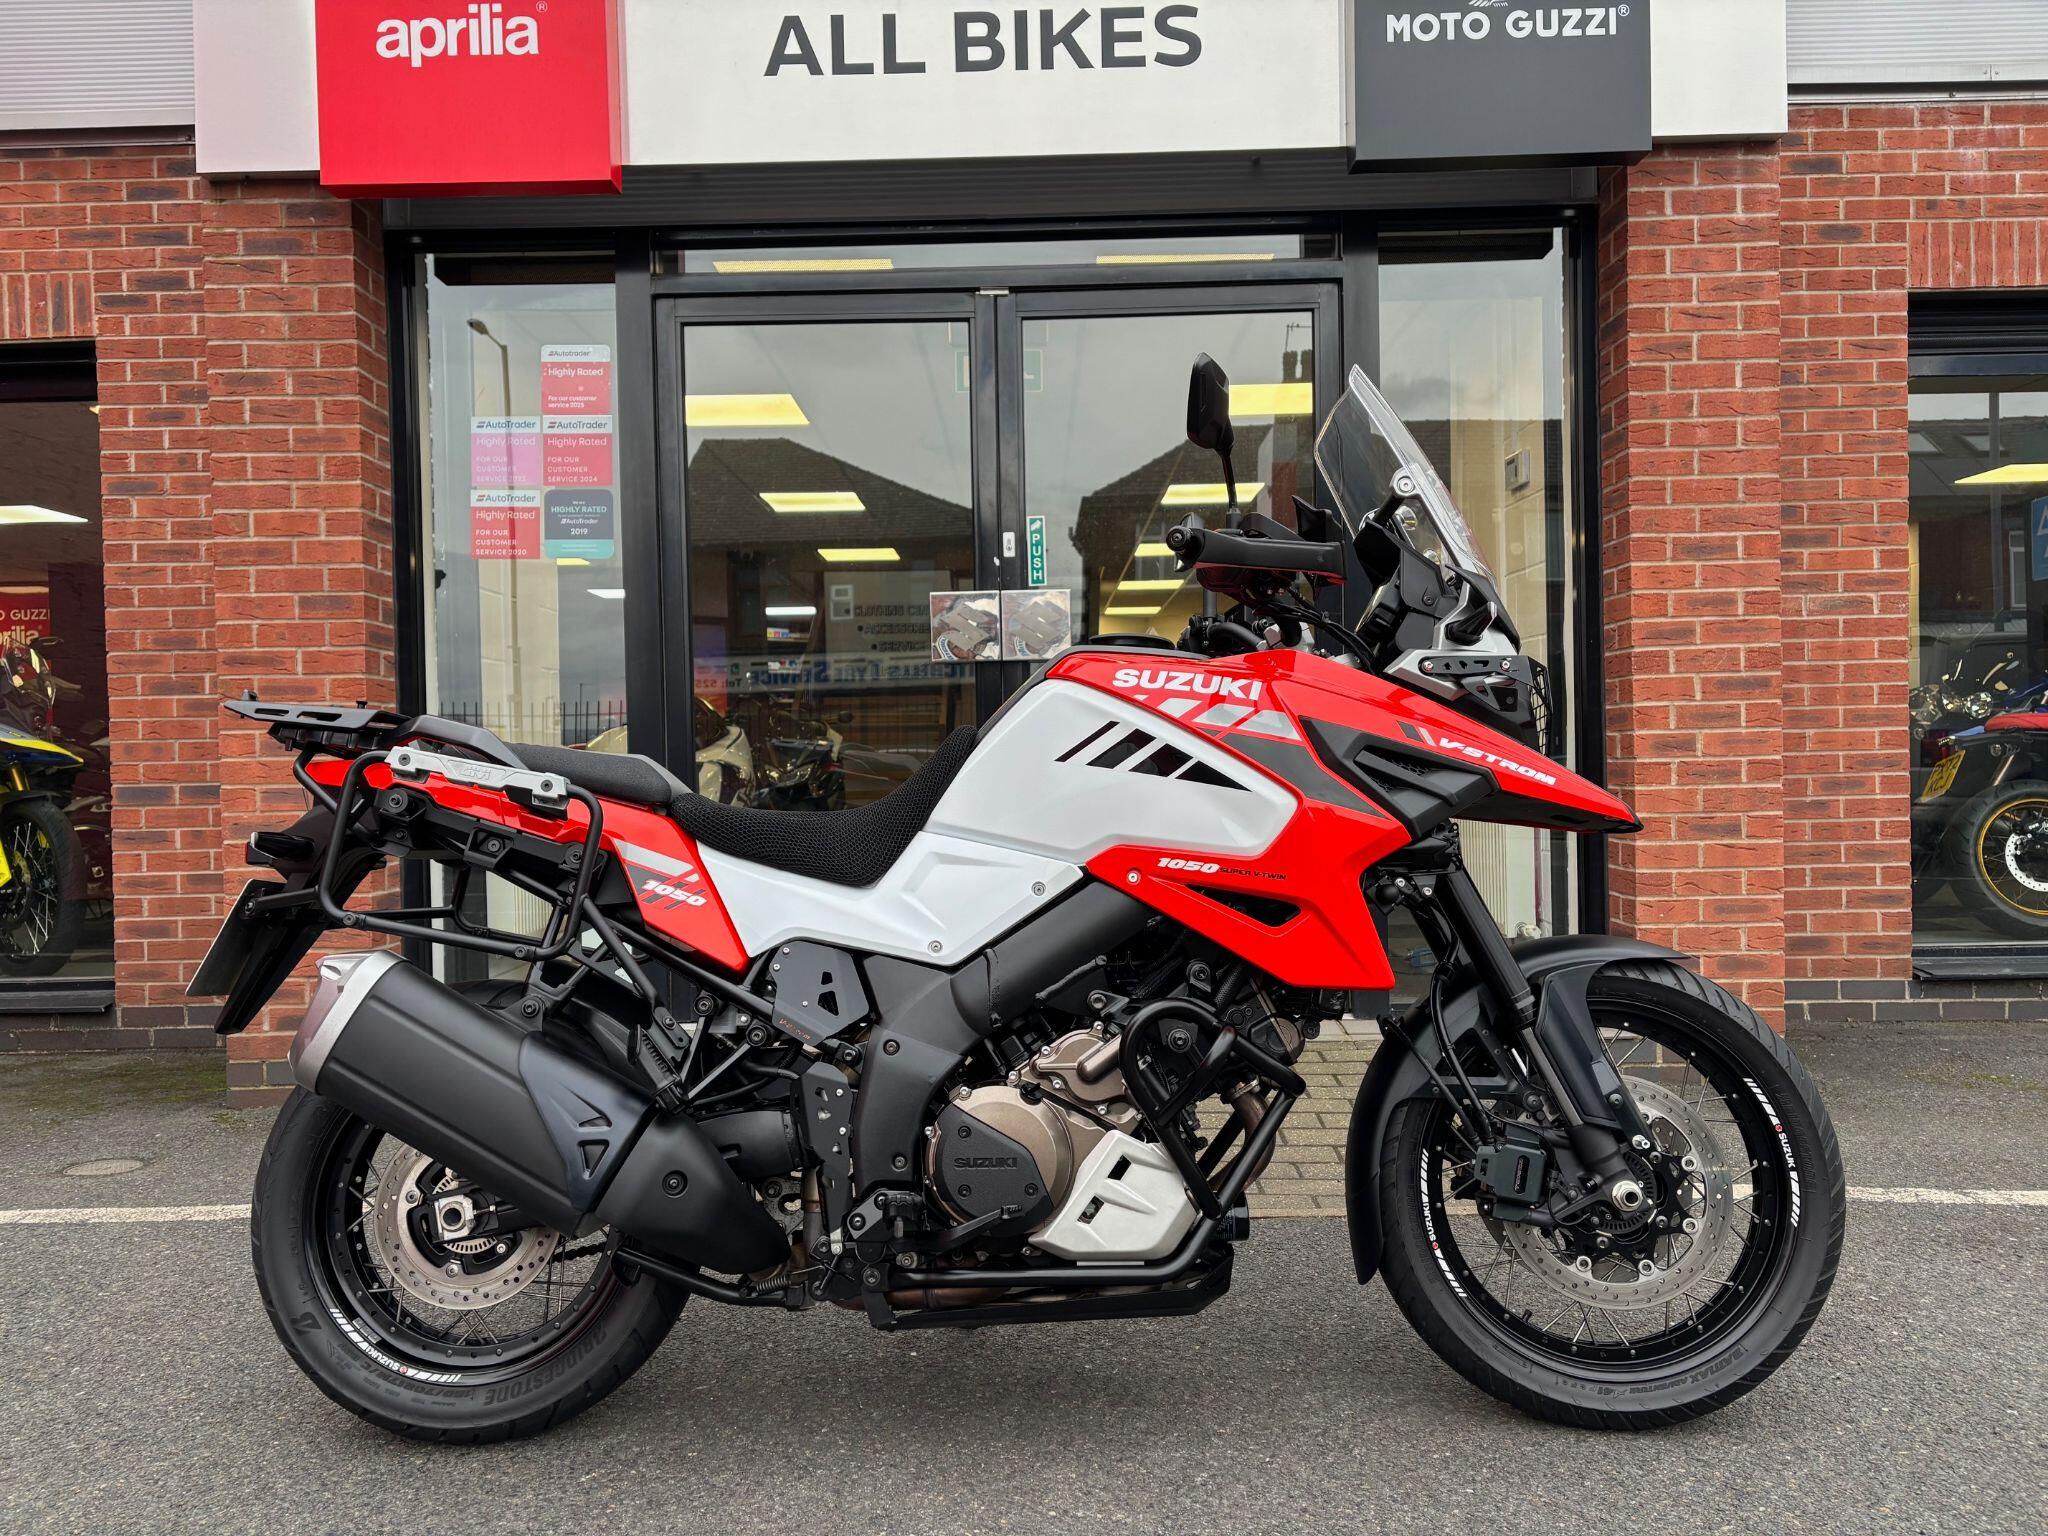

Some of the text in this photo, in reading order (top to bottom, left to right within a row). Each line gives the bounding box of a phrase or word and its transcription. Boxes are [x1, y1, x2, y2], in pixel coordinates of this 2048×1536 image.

[375, 3, 540, 68] aprilia
[1386, 7, 1617, 43] MOTO GUZZI
[763, 4, 1203, 77] ALL BIKES
[548, 368, 604, 378] Highly Rated
[485, 420, 537, 429] AutoTrader
[556, 420, 608, 429] AutoTrader
[476, 437, 507, 448] Highly
[547, 437, 607, 448] Highly Rated
[485, 494, 536, 503] AutoTrader
[475, 510, 535, 521] Highly Rated
[1032, 533, 1043, 580] PUSH
[1112, 669, 1263, 700] SUZUKI
[1439, 737, 1557, 785] V-STROM
[1157, 857, 1287, 880] 1050 SUPER V-TWIN
[642, 879, 708, 906] 1050
[953, 1157, 1018, 1170] SUZUKI
[365, 1345, 401, 1371] SUZUKI
